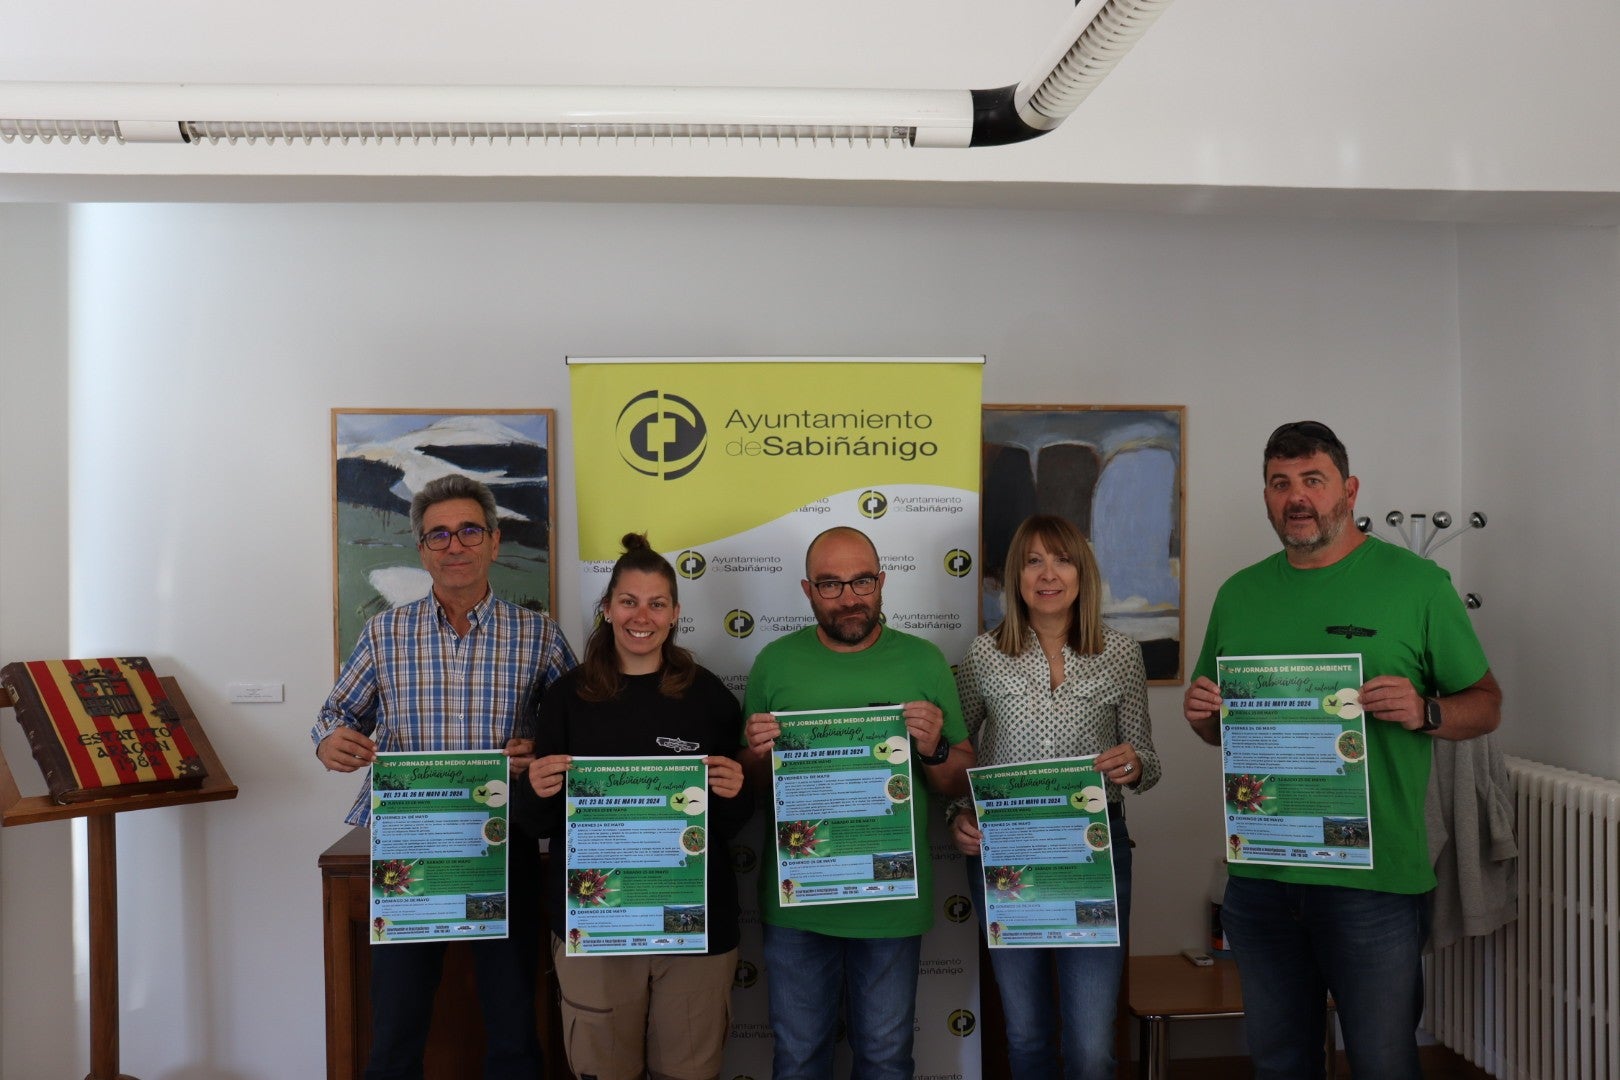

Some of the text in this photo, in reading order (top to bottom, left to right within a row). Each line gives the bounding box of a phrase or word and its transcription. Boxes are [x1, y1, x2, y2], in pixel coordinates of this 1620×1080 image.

[725, 408, 933, 433] Ayuntamiento
[725, 436, 938, 461] deSabiñánigo
[893, 496, 962, 505] Ayuntamiento
[712, 555, 781, 564] Ayuntamiento
[893, 612, 960, 621] Ayuntamiento
